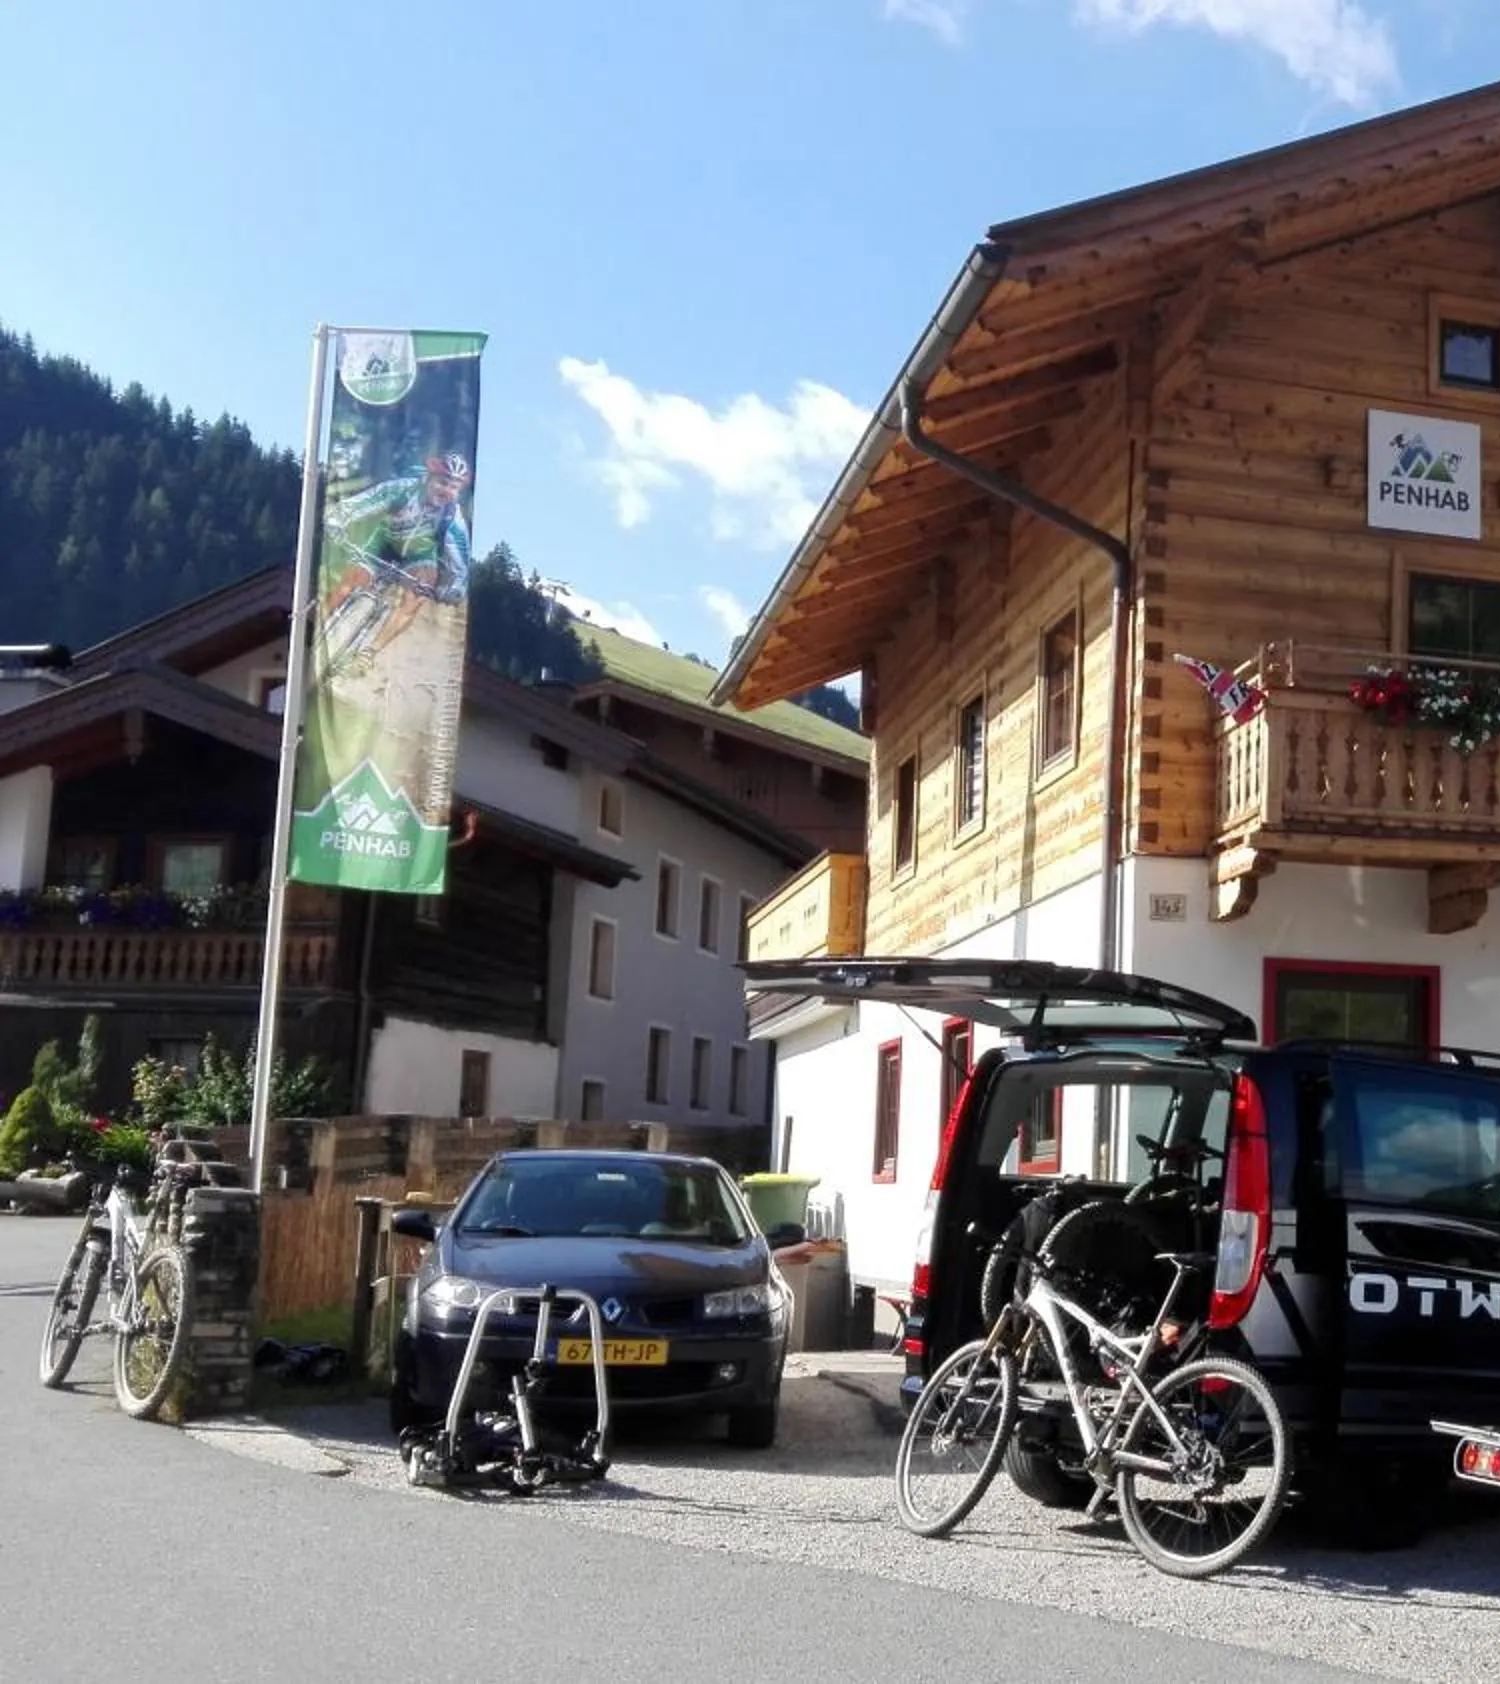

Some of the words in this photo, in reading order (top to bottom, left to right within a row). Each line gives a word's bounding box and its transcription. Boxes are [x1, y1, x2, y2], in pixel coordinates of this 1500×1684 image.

[1379, 481, 1470, 512] PENHAB
[320, 831, 411, 858] PENHAB
[567, 1343, 658, 1361] 67TH-JP
